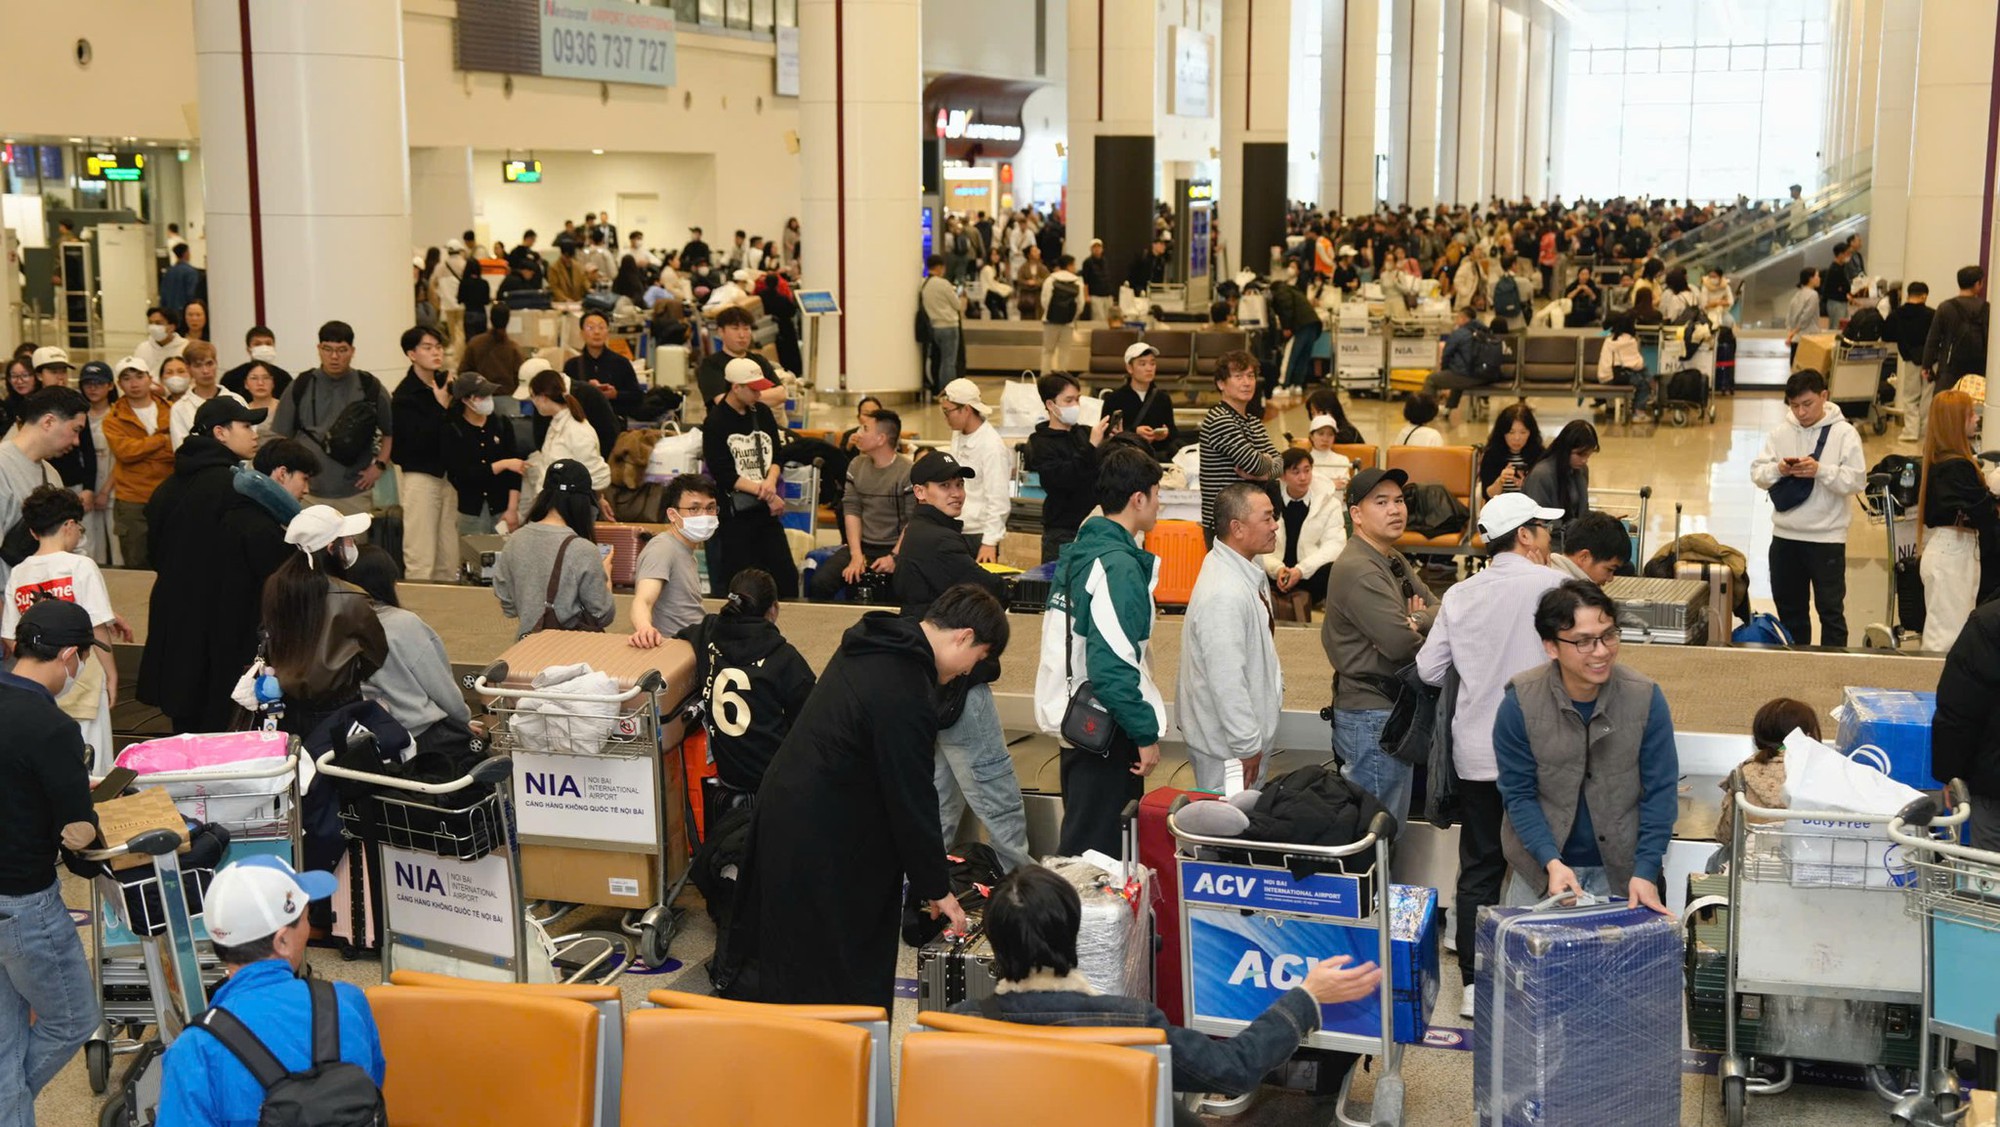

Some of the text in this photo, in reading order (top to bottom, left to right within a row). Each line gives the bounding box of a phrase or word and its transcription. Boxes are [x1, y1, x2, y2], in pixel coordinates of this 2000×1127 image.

[553, 27, 667, 73] 0936 737 727
[1394, 346, 1413, 355] NIA
[712, 667, 752, 737] 6
[525, 772, 582, 798] NIA
[589, 785, 639, 794] INTERNATIONAL
[589, 793, 618, 801] AIRPORT
[395, 861, 447, 896] NIA
[1193, 872, 1256, 898] ACV
[452, 882, 498, 899] INTERNATIONAL
[453, 893, 478, 903] AIRPORT
[1264, 887, 1341, 899] INTERNATIONAL AIRPORT
